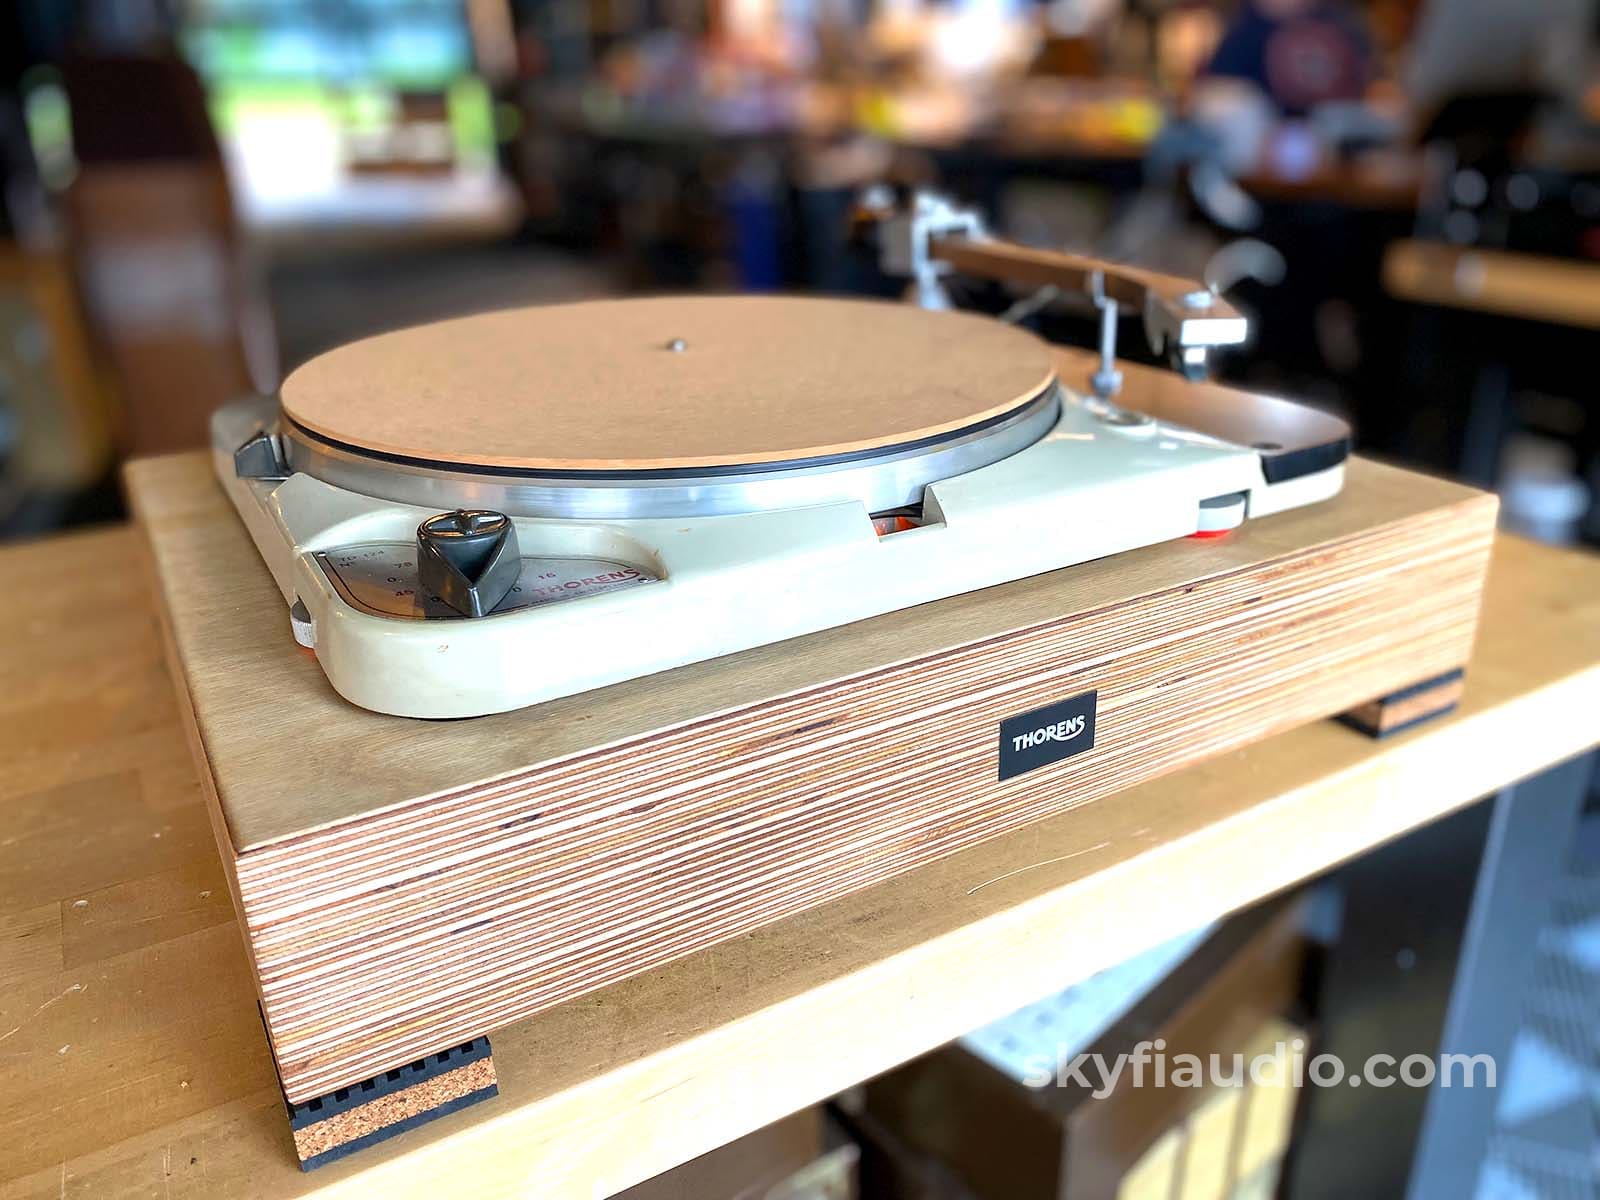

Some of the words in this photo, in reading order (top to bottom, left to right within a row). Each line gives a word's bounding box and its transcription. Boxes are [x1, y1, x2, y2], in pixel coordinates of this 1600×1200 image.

[532, 567, 641, 598] THORENS
[537, 571, 556, 580] 16
[1012, 714, 1086, 752] THORENS
